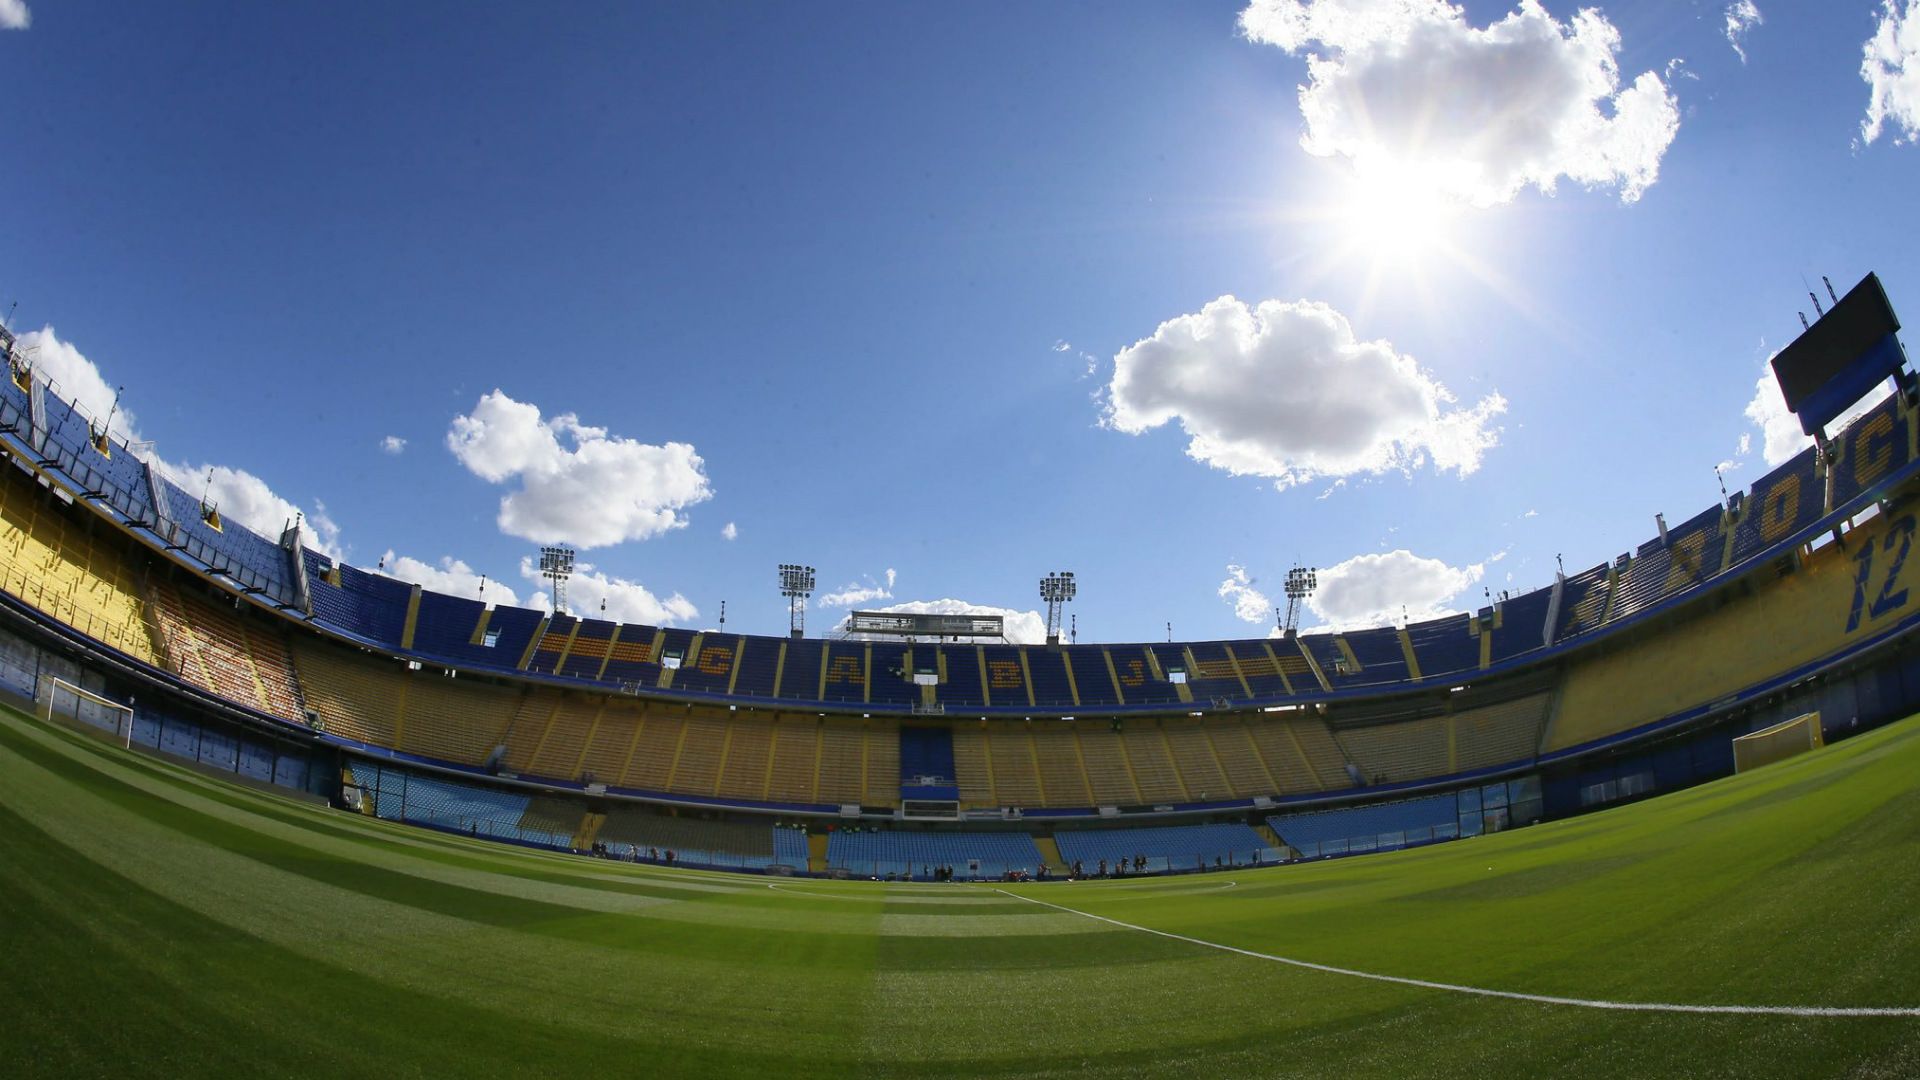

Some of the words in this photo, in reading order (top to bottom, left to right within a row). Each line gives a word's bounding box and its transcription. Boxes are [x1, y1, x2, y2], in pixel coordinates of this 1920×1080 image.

[1855, 412, 1893, 485] C
[1846, 514, 1916, 633] 12
[699, 647, 732, 674] C
[826, 656, 865, 684] A
[989, 661, 1022, 688] B
[1120, 660, 1143, 686] J
